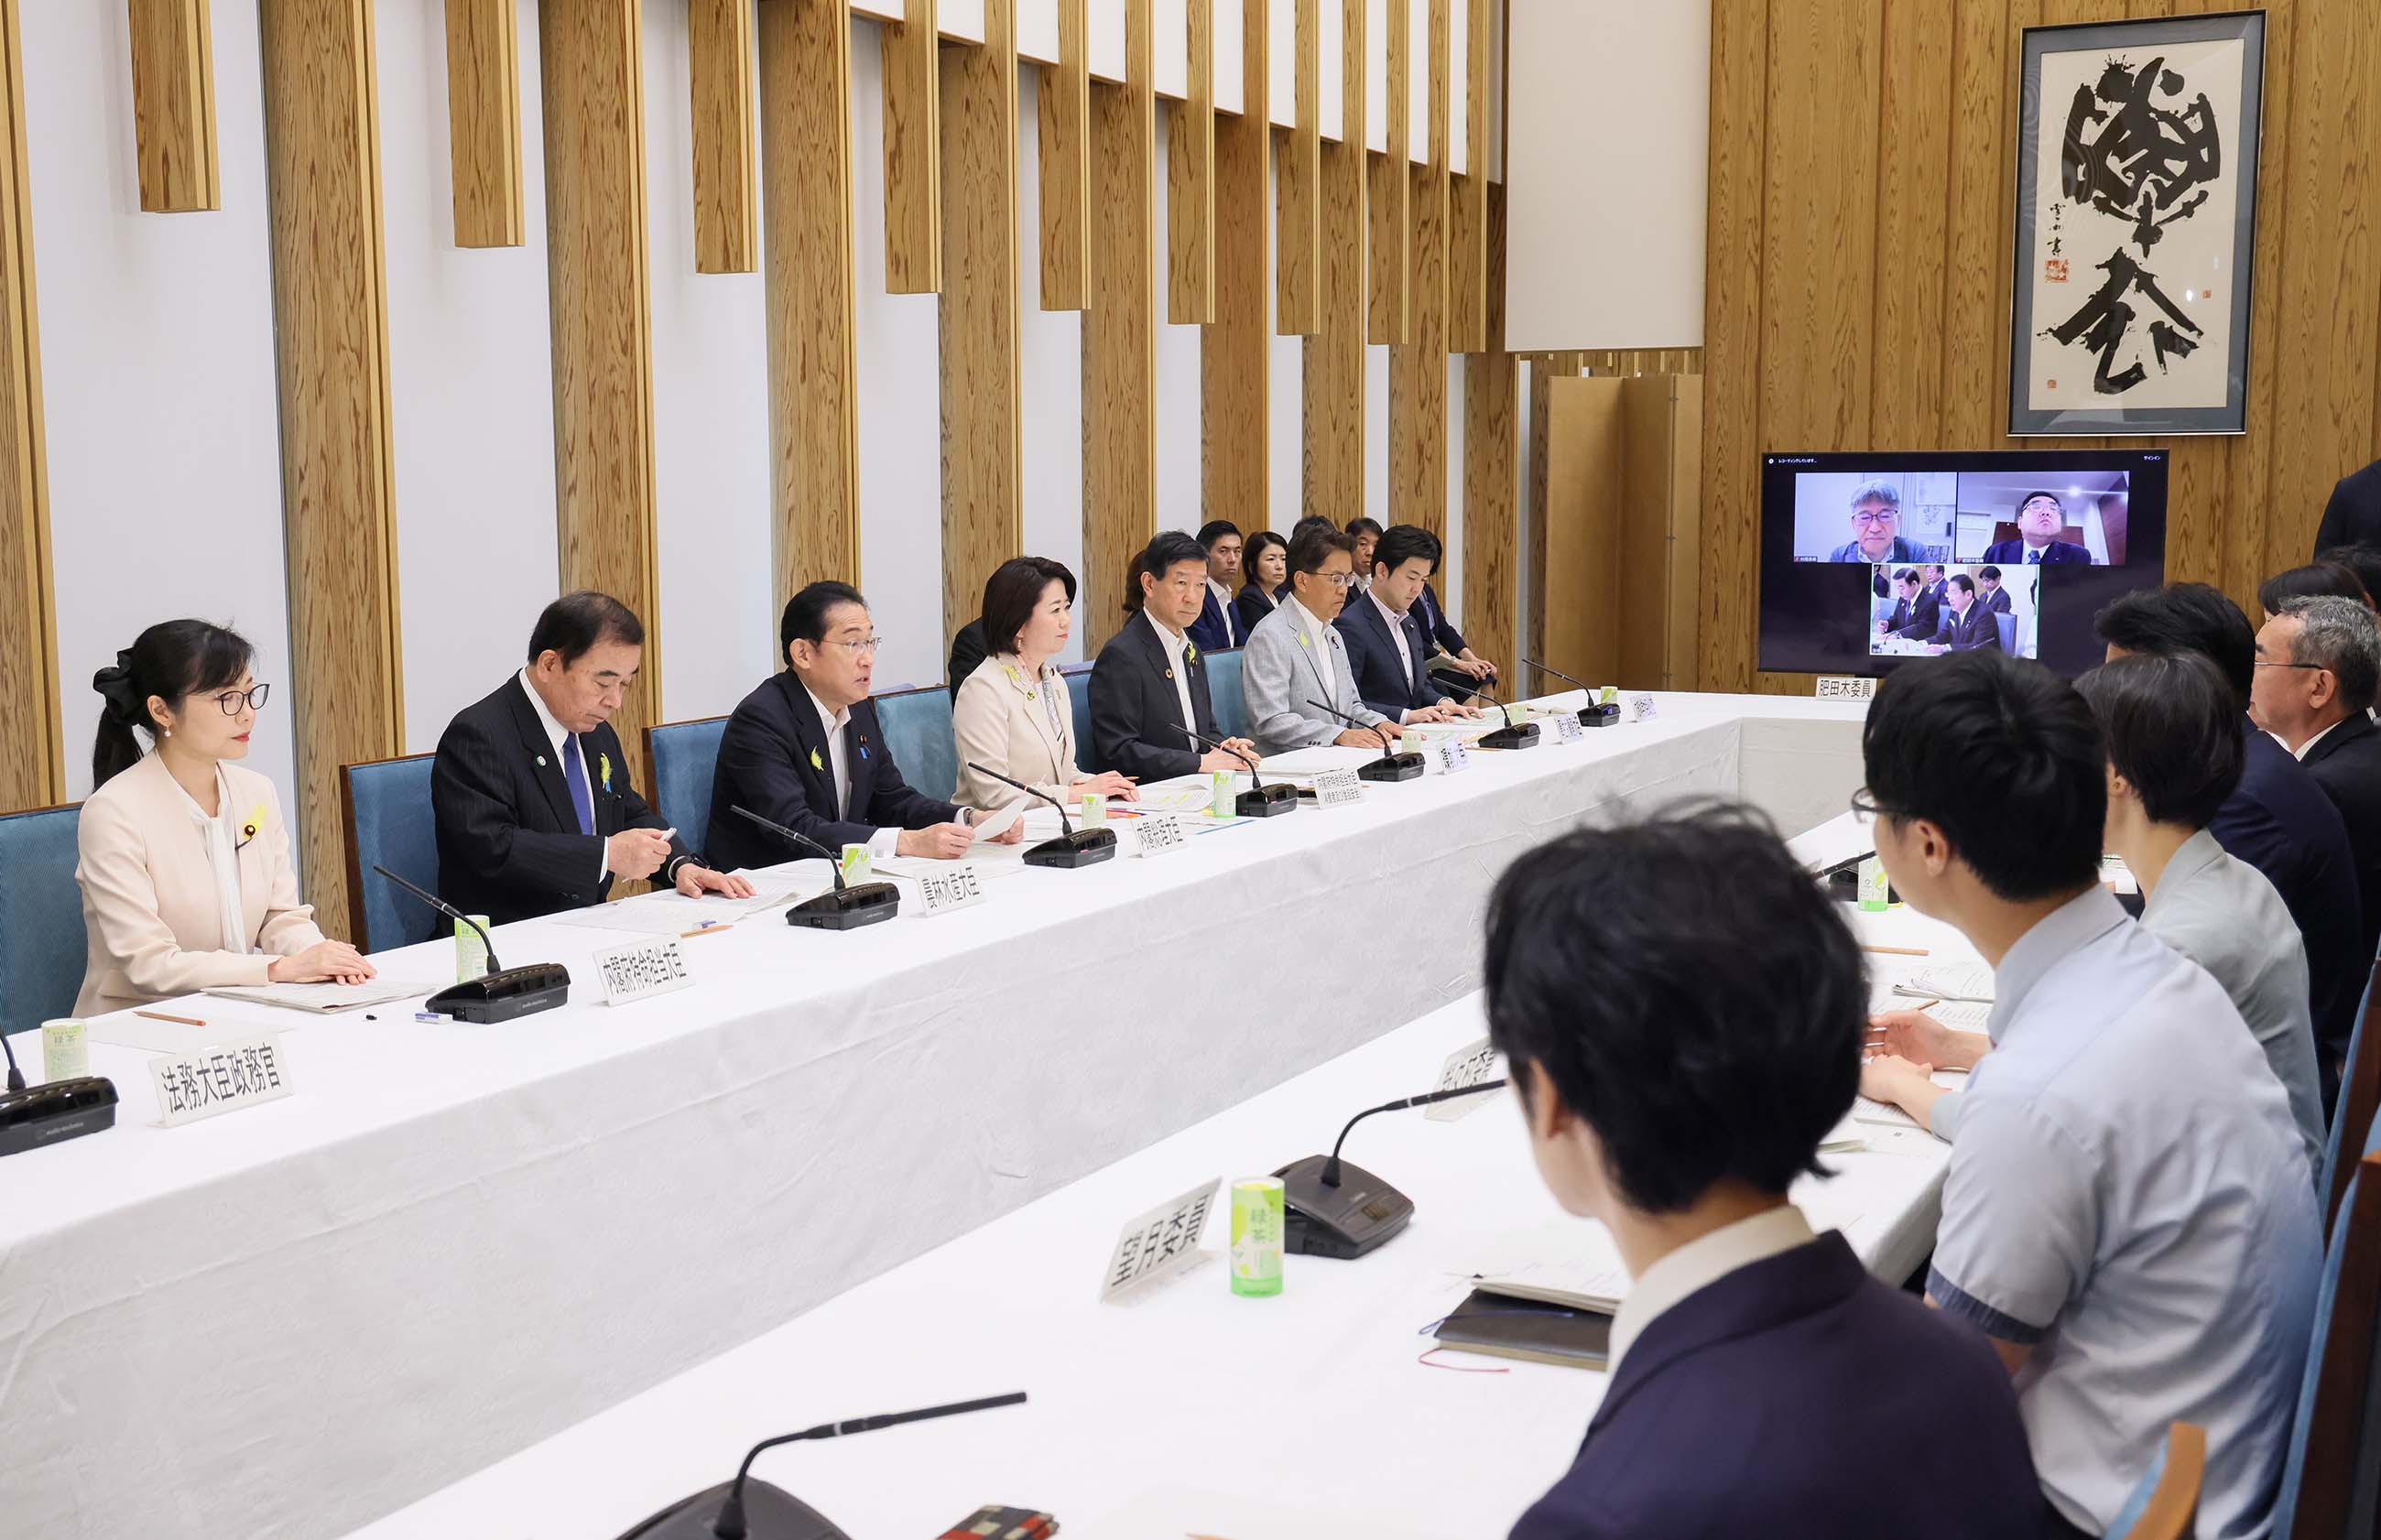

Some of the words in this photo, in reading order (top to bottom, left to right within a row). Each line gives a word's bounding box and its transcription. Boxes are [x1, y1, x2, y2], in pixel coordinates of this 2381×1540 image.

[1819, 679, 1871, 697] 肥田木委員
[1136, 817, 1183, 850] 内閣総理大臣
[921, 866, 980, 910] 農林水産大臣
[603, 942, 687, 996] 内閣府特命担当大臣
[161, 1042, 281, 1113] 法務大臣政務官
[1111, 1193, 1211, 1286] 望月委員
